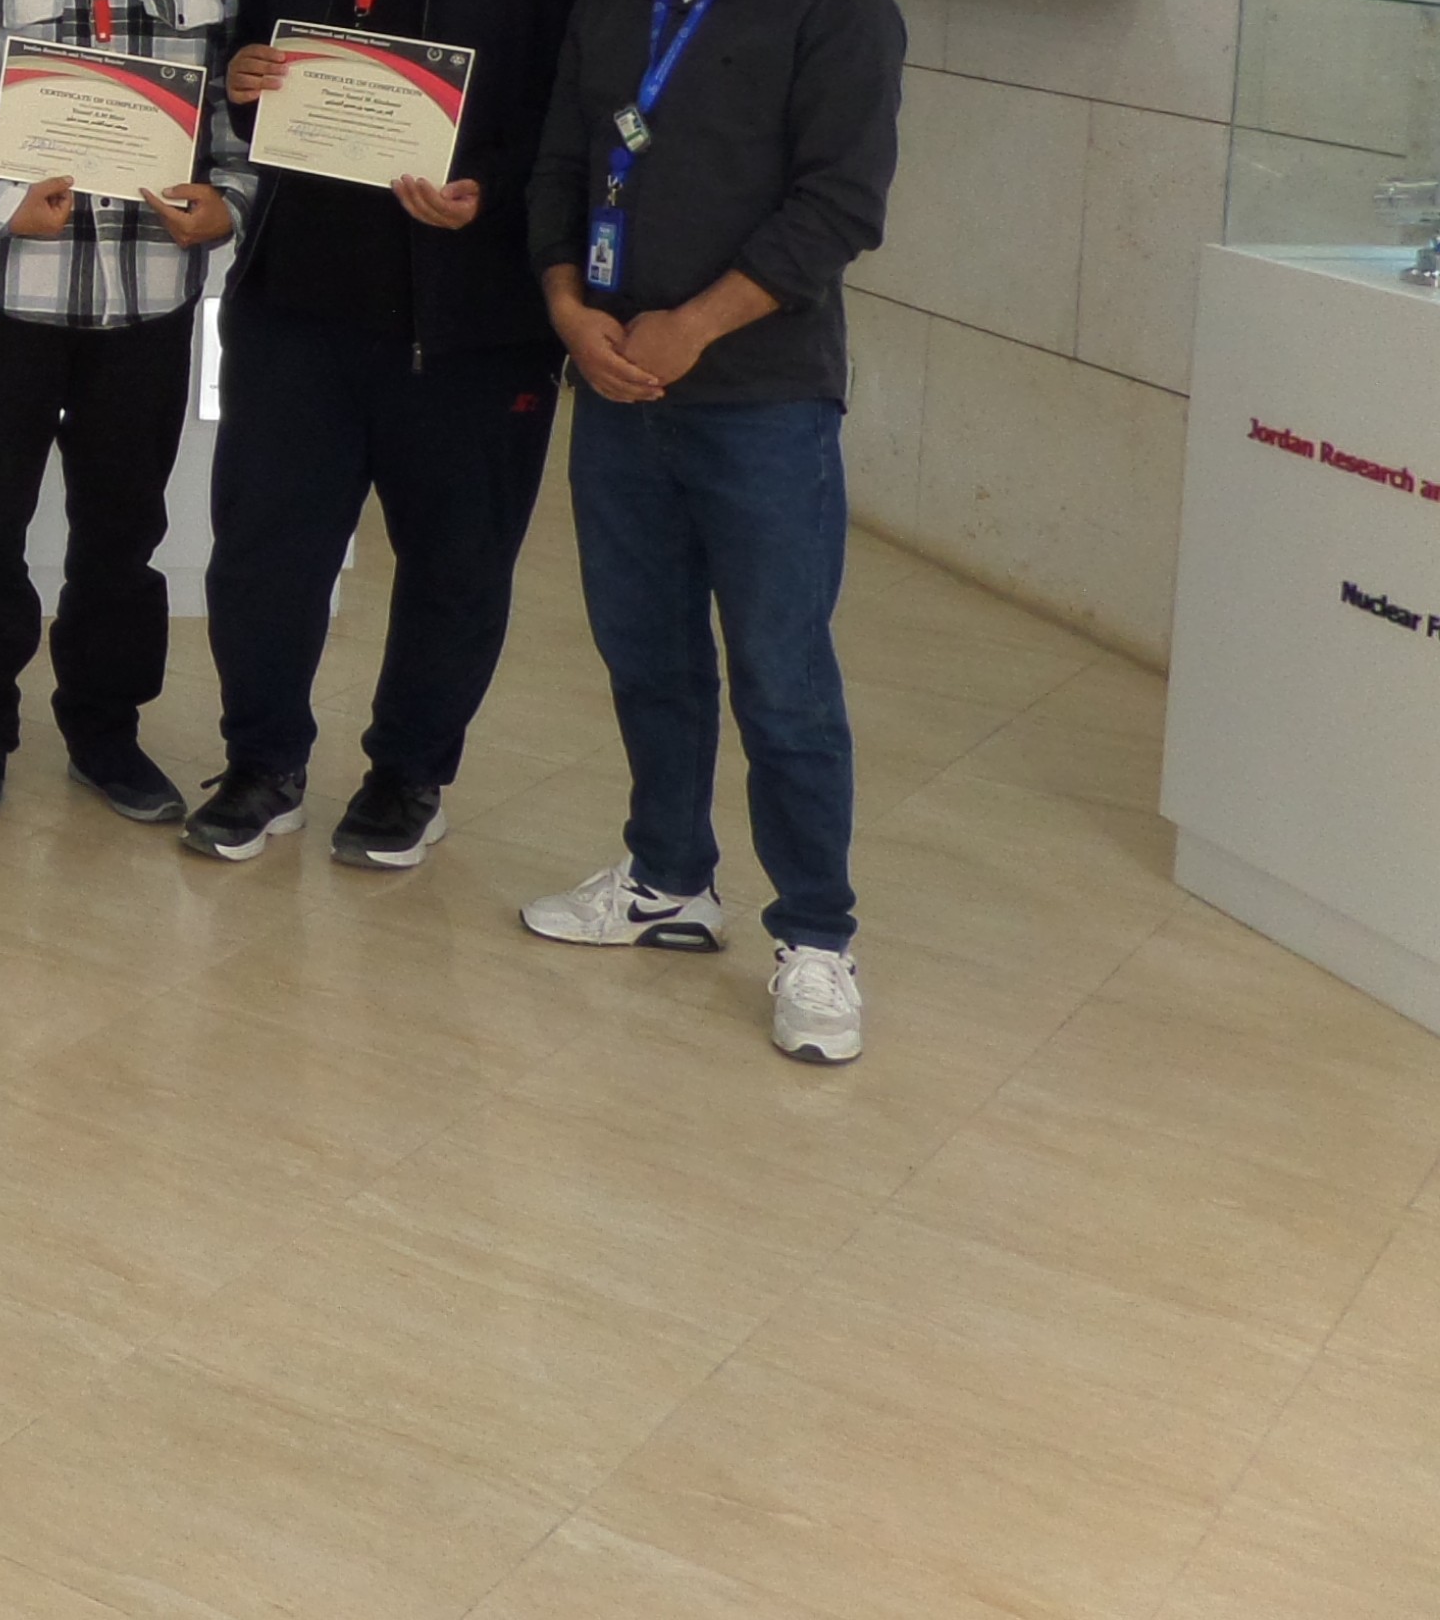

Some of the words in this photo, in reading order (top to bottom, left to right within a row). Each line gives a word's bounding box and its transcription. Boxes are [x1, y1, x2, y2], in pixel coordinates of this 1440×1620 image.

[1247, 417, 1315, 459] Jordan
[1320, 441, 1414, 493] Research
[1341, 580, 1422, 631] Nuclear
[1427, 614, 1440, 641] F
